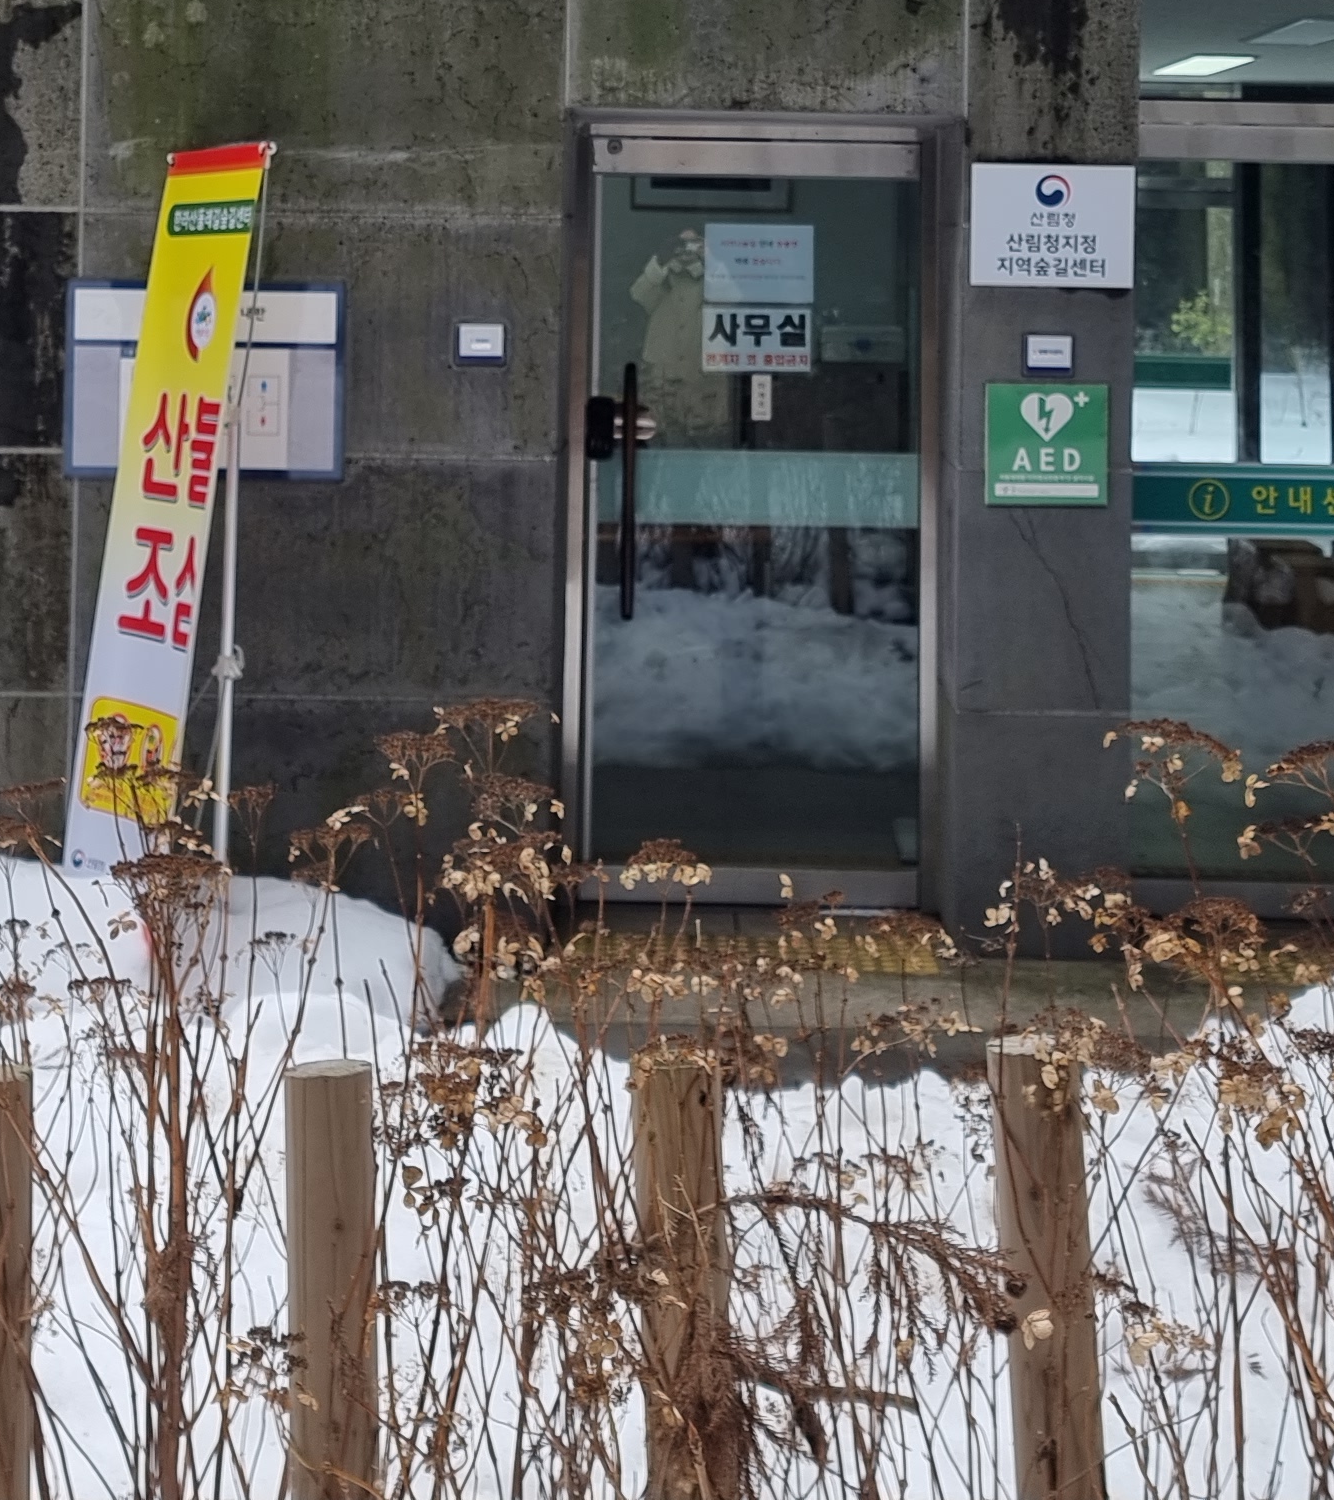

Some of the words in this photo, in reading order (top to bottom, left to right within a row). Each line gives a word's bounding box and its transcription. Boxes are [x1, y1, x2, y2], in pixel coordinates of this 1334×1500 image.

[1029, 211, 1077, 229] 산림청
[1005, 233, 1098, 255] 산림청지정
[996, 256, 1107, 279] 지역숲길센터
[707, 312, 807, 348] 사무실
[1011, 447, 1082, 473] AED
